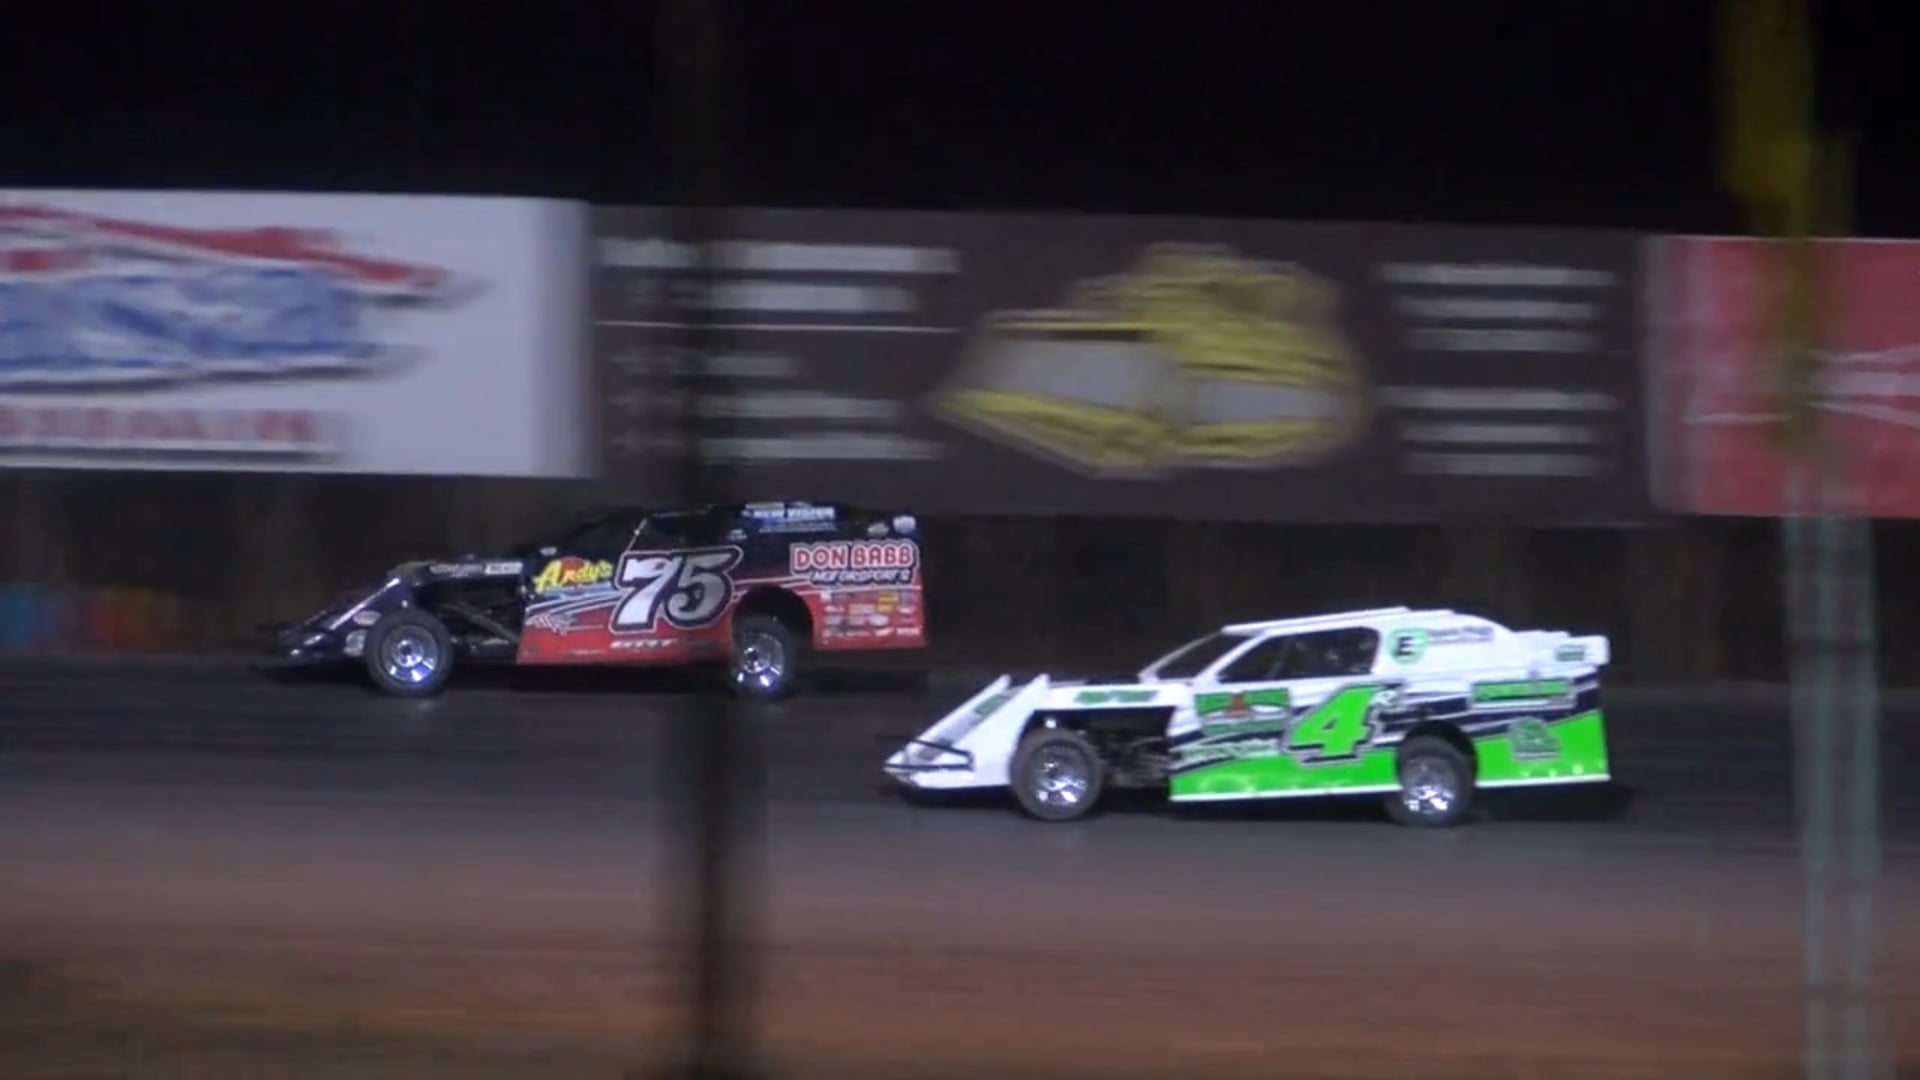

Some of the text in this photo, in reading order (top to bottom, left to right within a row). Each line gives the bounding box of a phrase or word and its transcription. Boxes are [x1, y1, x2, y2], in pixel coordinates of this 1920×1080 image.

[794, 543, 914, 571] DON BABB
[613, 549, 737, 631] 75
